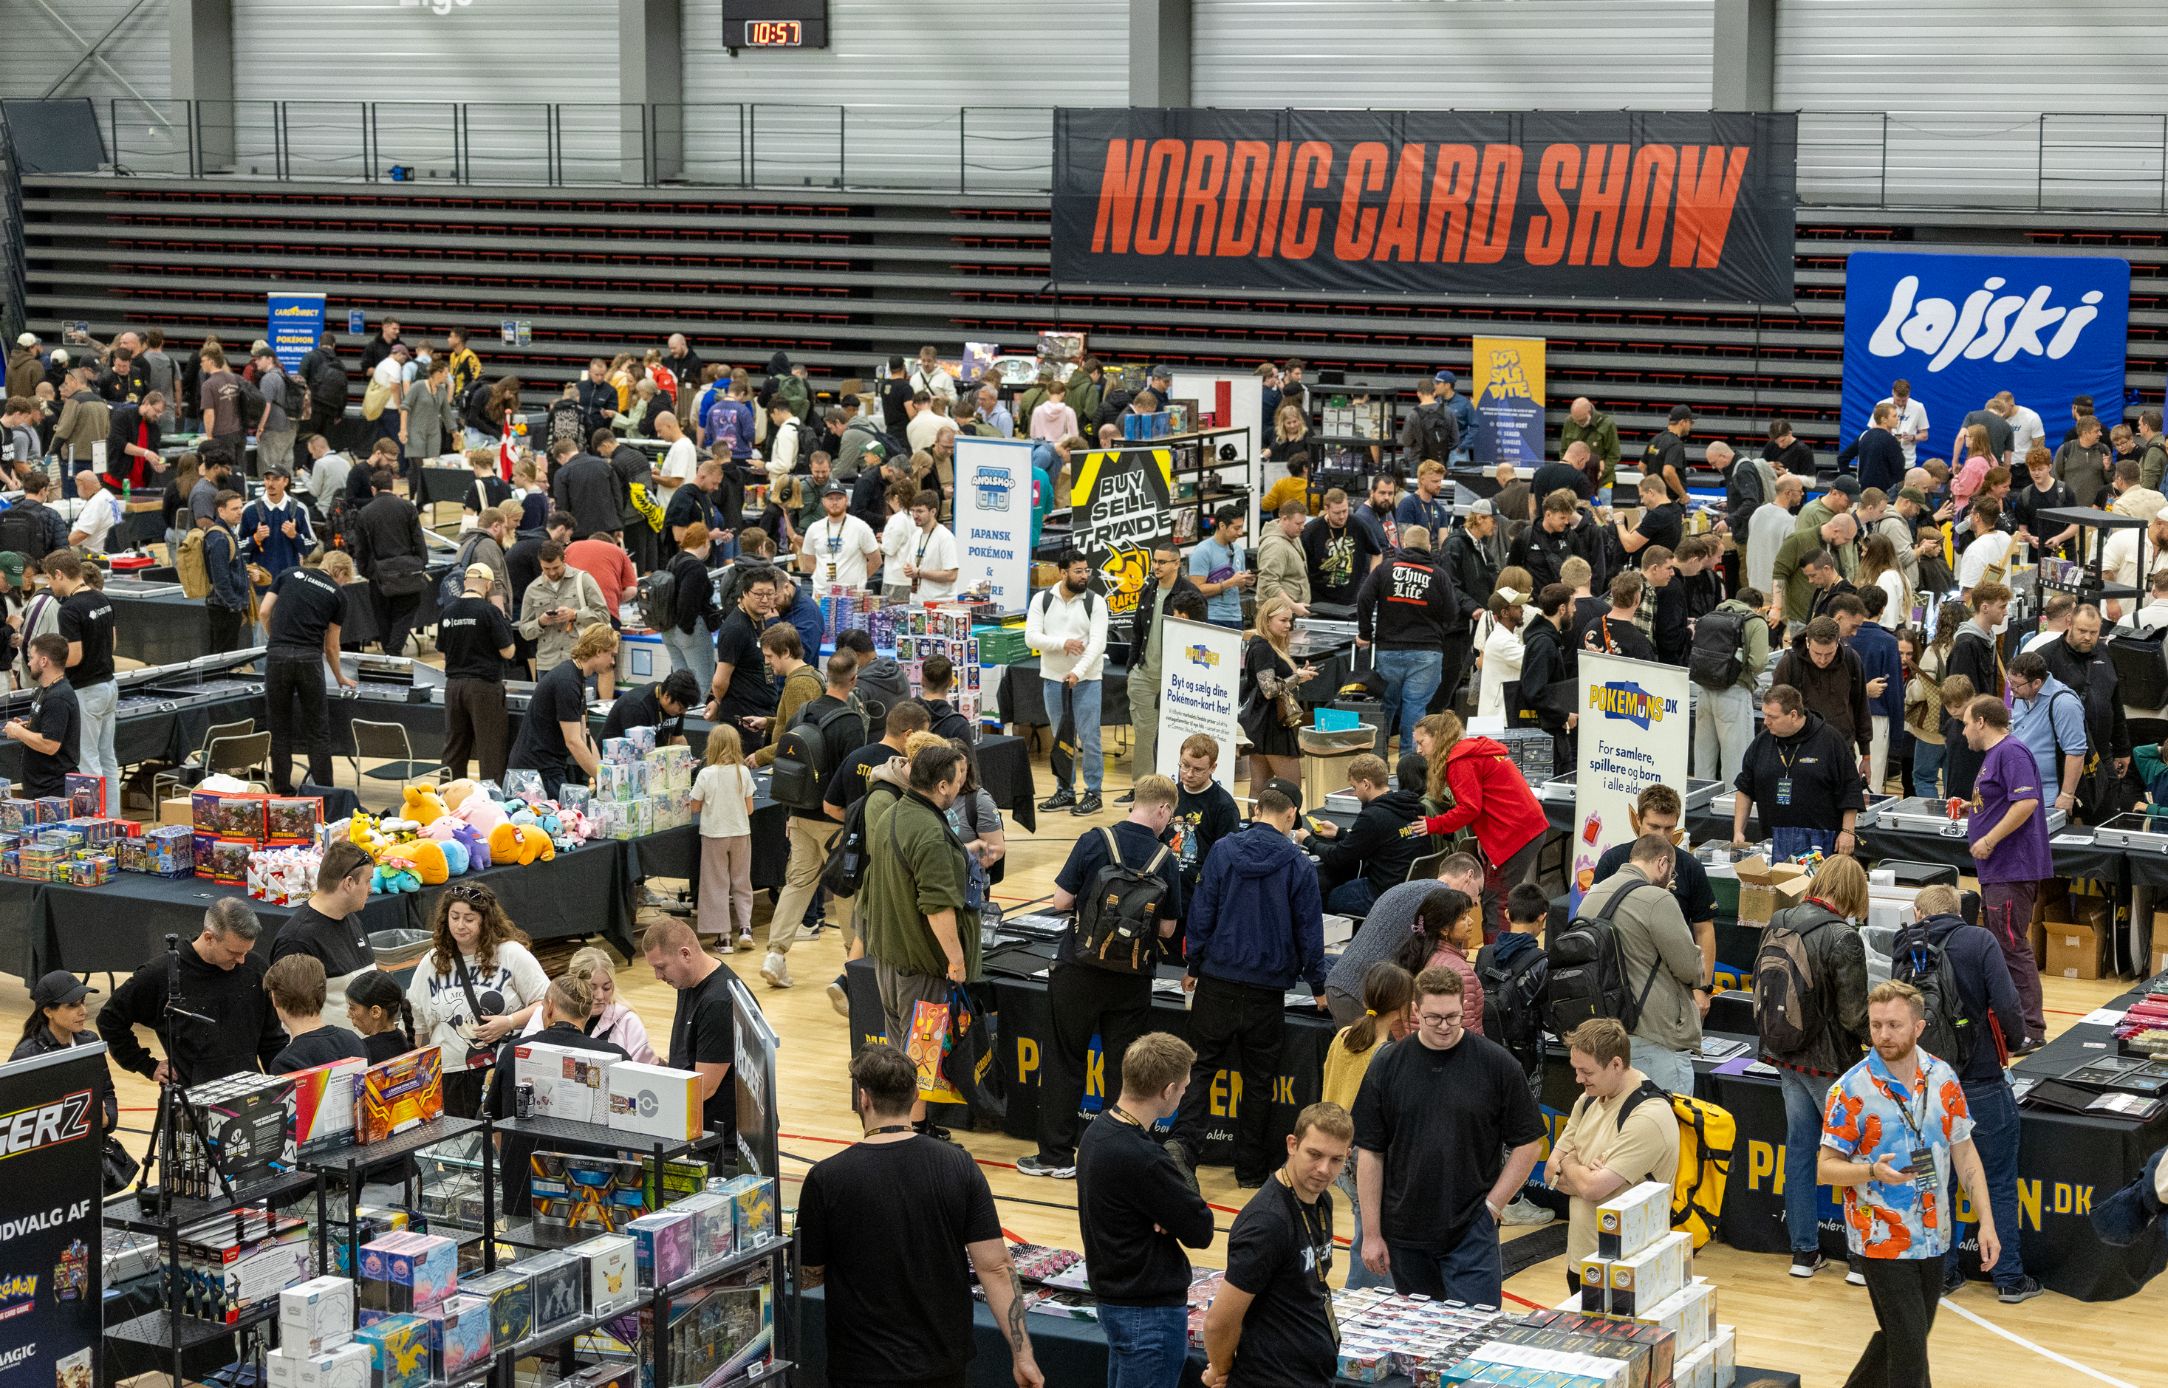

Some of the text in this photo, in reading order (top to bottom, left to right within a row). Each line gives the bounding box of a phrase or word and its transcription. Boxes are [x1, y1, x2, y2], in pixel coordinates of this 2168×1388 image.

[753, 22, 799, 44] 10:57
[1091, 138, 1749, 269] NORDIC CARD SHOW
[1868, 275, 2104, 373] lajski
[971, 475, 1016, 490] ANDISHOP
[1100, 469, 1145, 499] BUY
[1091, 491, 1157, 528] SELL
[970, 528, 1011, 541] JAPANSK
[1073, 510, 1171, 554] TRADE
[968, 545, 1013, 560] POKÉMON
[986, 566, 994, 577] &
[1392, 567, 1431, 588] Thug
[307, 577, 336, 595] CARDSTORE
[1393, 582, 1423, 600] Life
[1172, 673, 1228, 699] Byt og sælg dine
[1167, 689, 1231, 715] Pokémon-kort her!
[1598, 739, 1655, 766] For samlere,
[857, 763, 872, 777] STA
[1589, 758, 1662, 783] spillere og børn
[1603, 776, 1607, 789] i
[1607, 777, 1624, 792] alle
[1206, 1129, 1234, 1142] aldre
[0, 1199, 91, 1242] DVALG AF
[1958, 1238, 1979, 1251] alle
